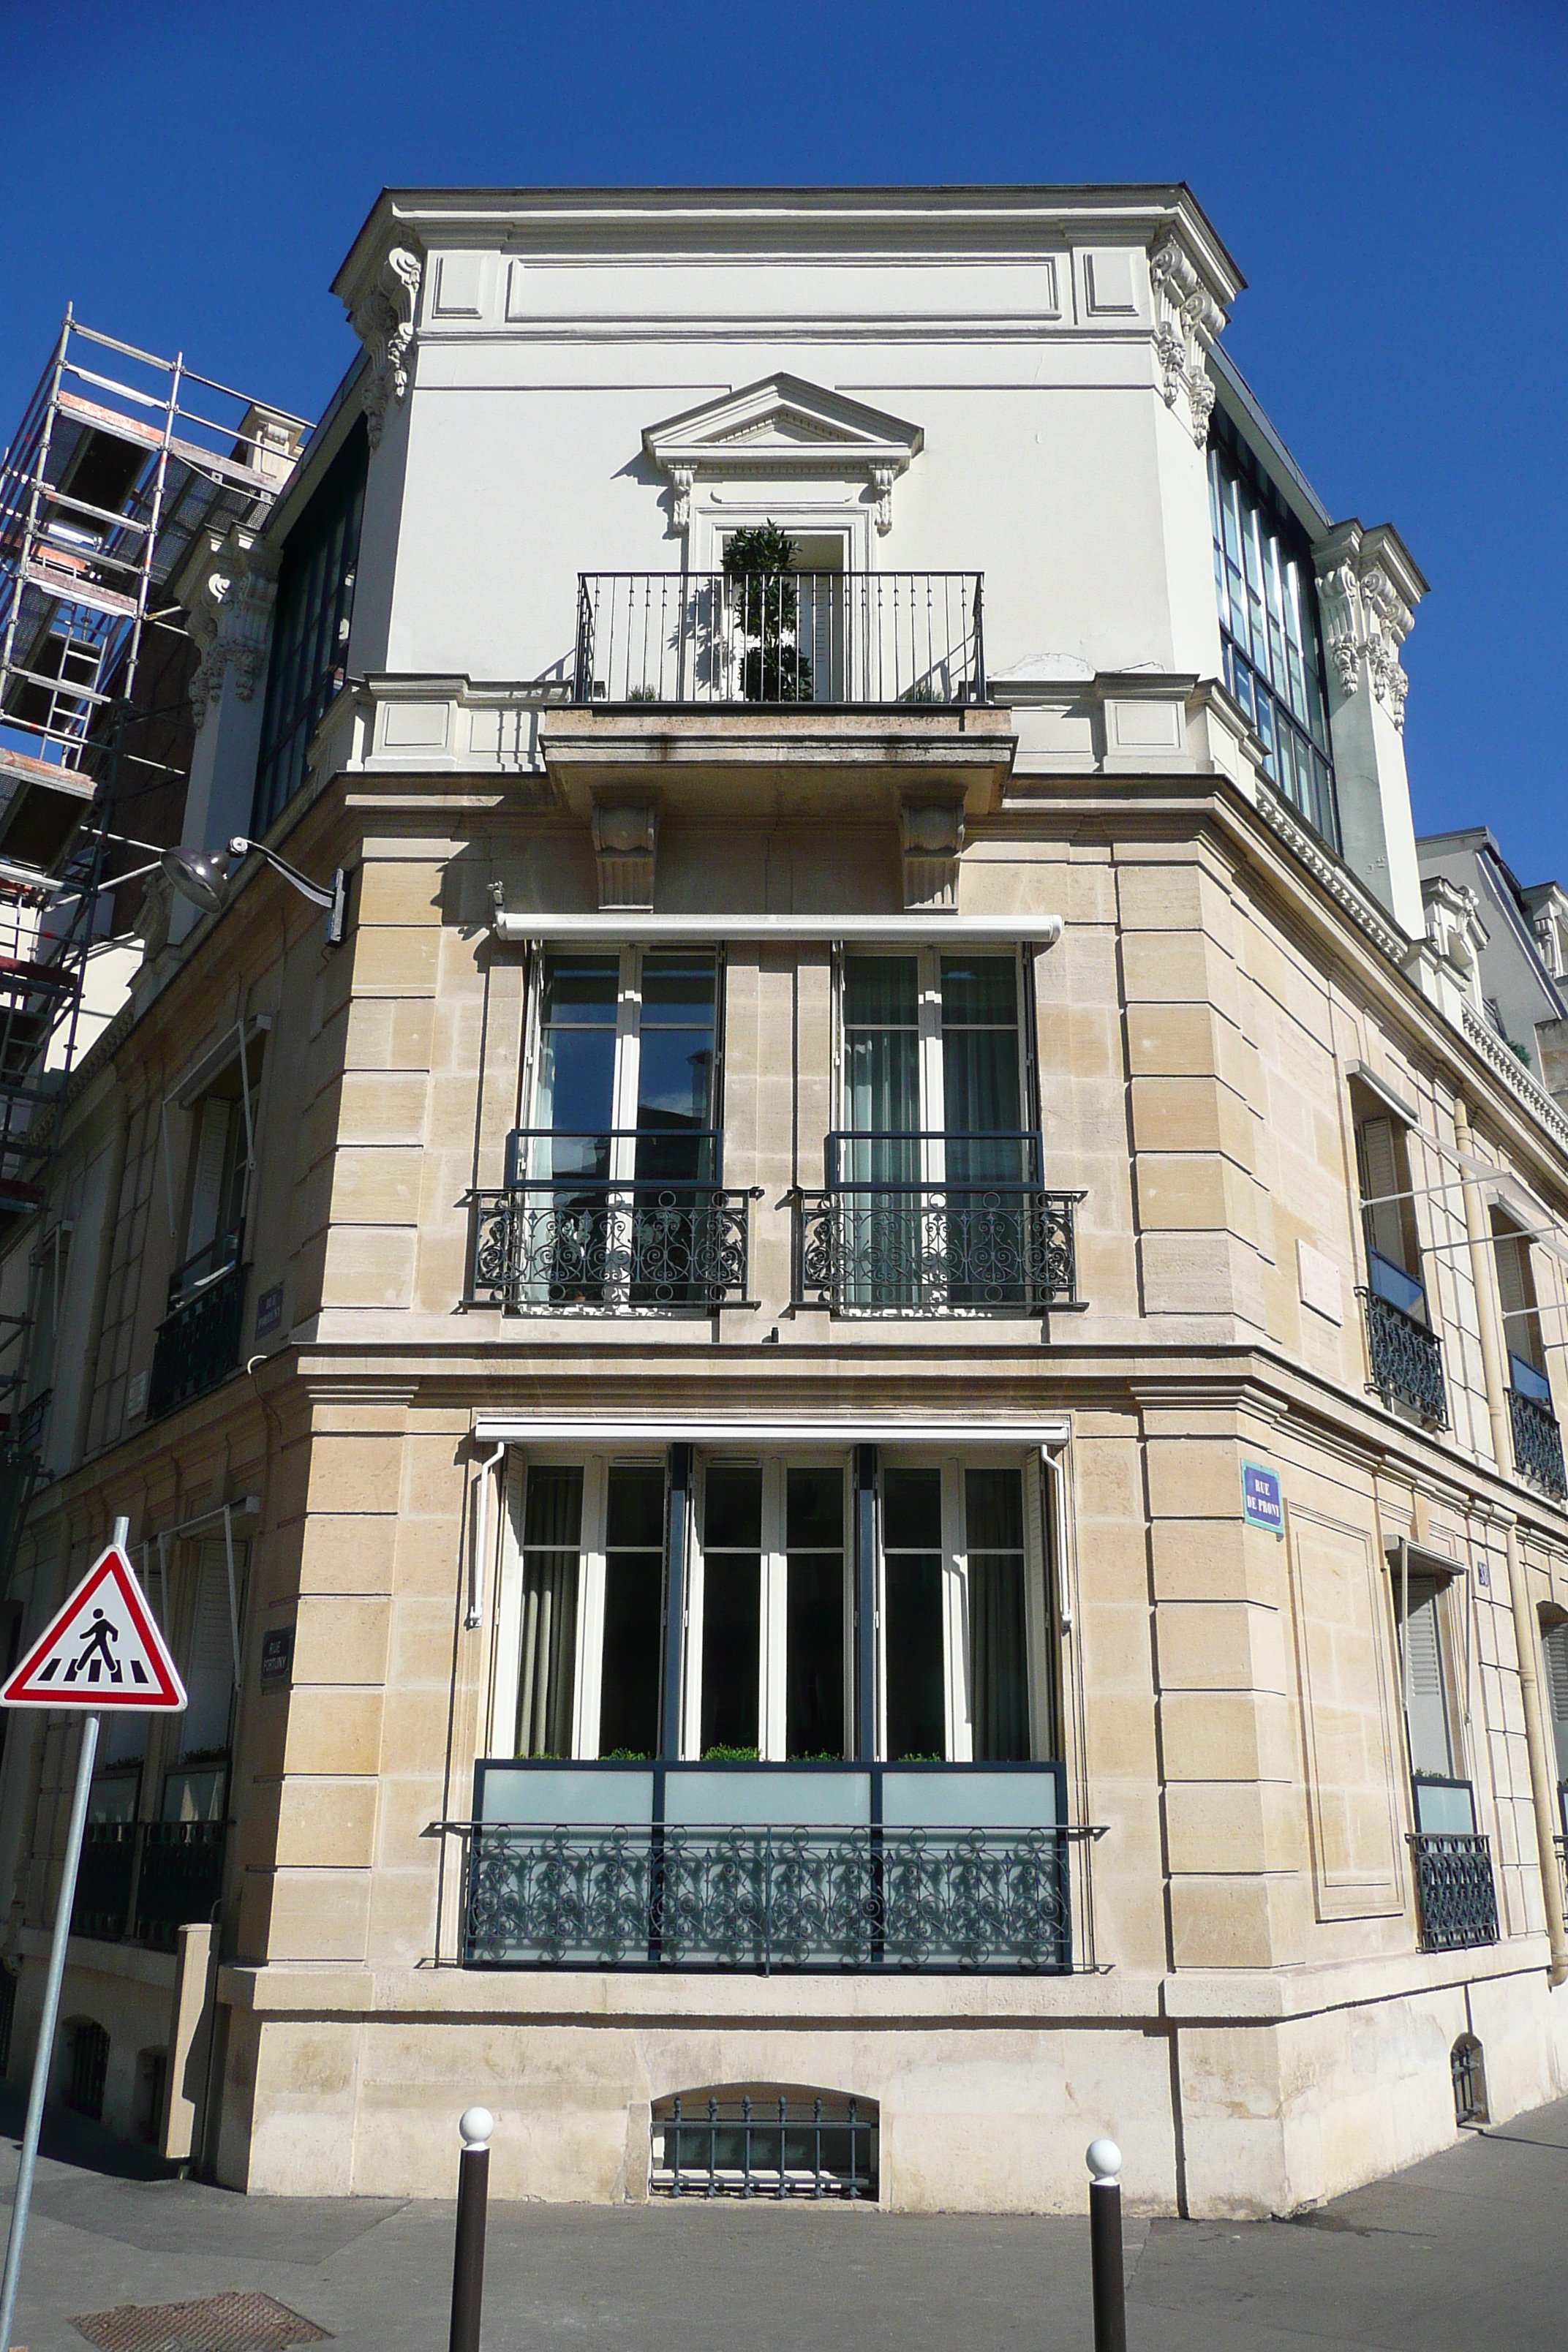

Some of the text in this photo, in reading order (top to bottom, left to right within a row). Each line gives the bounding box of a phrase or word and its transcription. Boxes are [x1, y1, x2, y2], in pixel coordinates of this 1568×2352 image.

[266, 1294, 276, 1309] RUE
[1255, 1479, 1270, 1496] RUE
[1246, 1495, 1280, 1518] DE PRONY
[269, 1640, 282, 1654] RUE
[263, 1656, 287, 1672] FORTUNY
